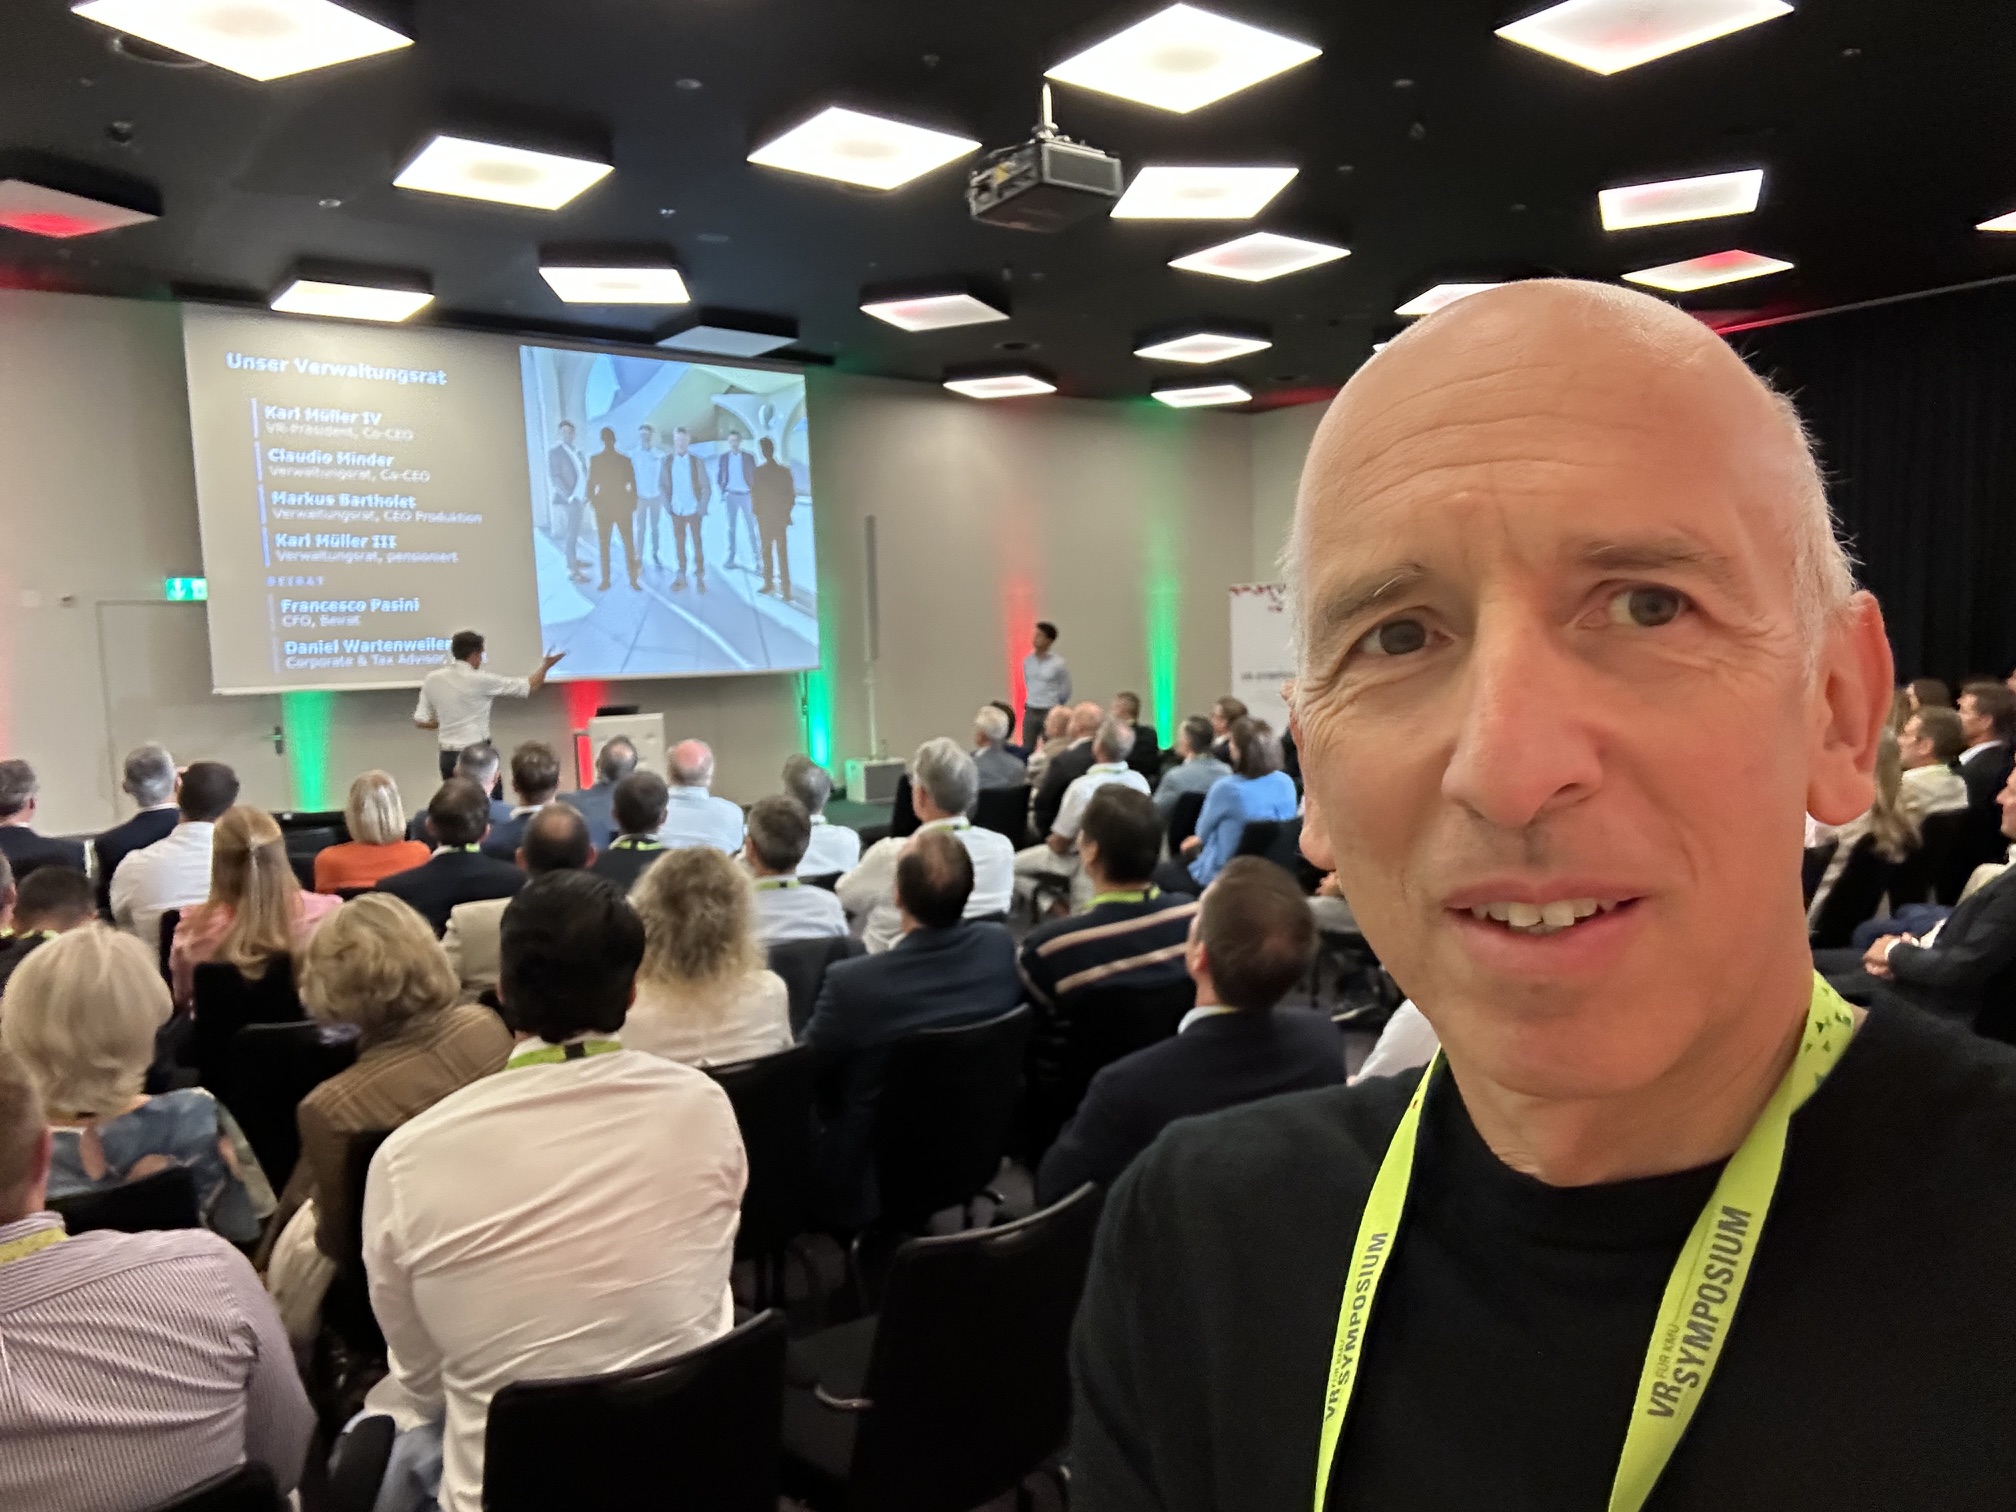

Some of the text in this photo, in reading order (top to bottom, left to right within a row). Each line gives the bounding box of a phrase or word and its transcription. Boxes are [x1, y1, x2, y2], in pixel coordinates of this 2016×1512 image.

[225, 352, 448, 386] Unser Verwaltungsrat
[264, 405, 382, 425] Karl Müller IV
[268, 447, 394, 467] Claudio Minder
[271, 491, 417, 509] Markus Bartholet
[383, 509, 412, 522] CEO
[415, 511, 483, 524] Produktion
[275, 533, 397, 549] Karl Müller III
[280, 598, 420, 613] Francesco Pasini
[284, 637, 453, 655] Daniel Wartenweiler
[285, 656, 353, 669] Corporate
[357, 655, 368, 666] &
[371, 654, 393, 666] Tax
[1673, 1205, 1752, 1388] SYMPOSIUM
[1338, 1232, 1388, 1385] SYMPOSIUM
[1662, 1324, 1680, 1352] KMU
[1325, 1388, 1341, 1421] VR
[1647, 1381, 1681, 1418] VR
